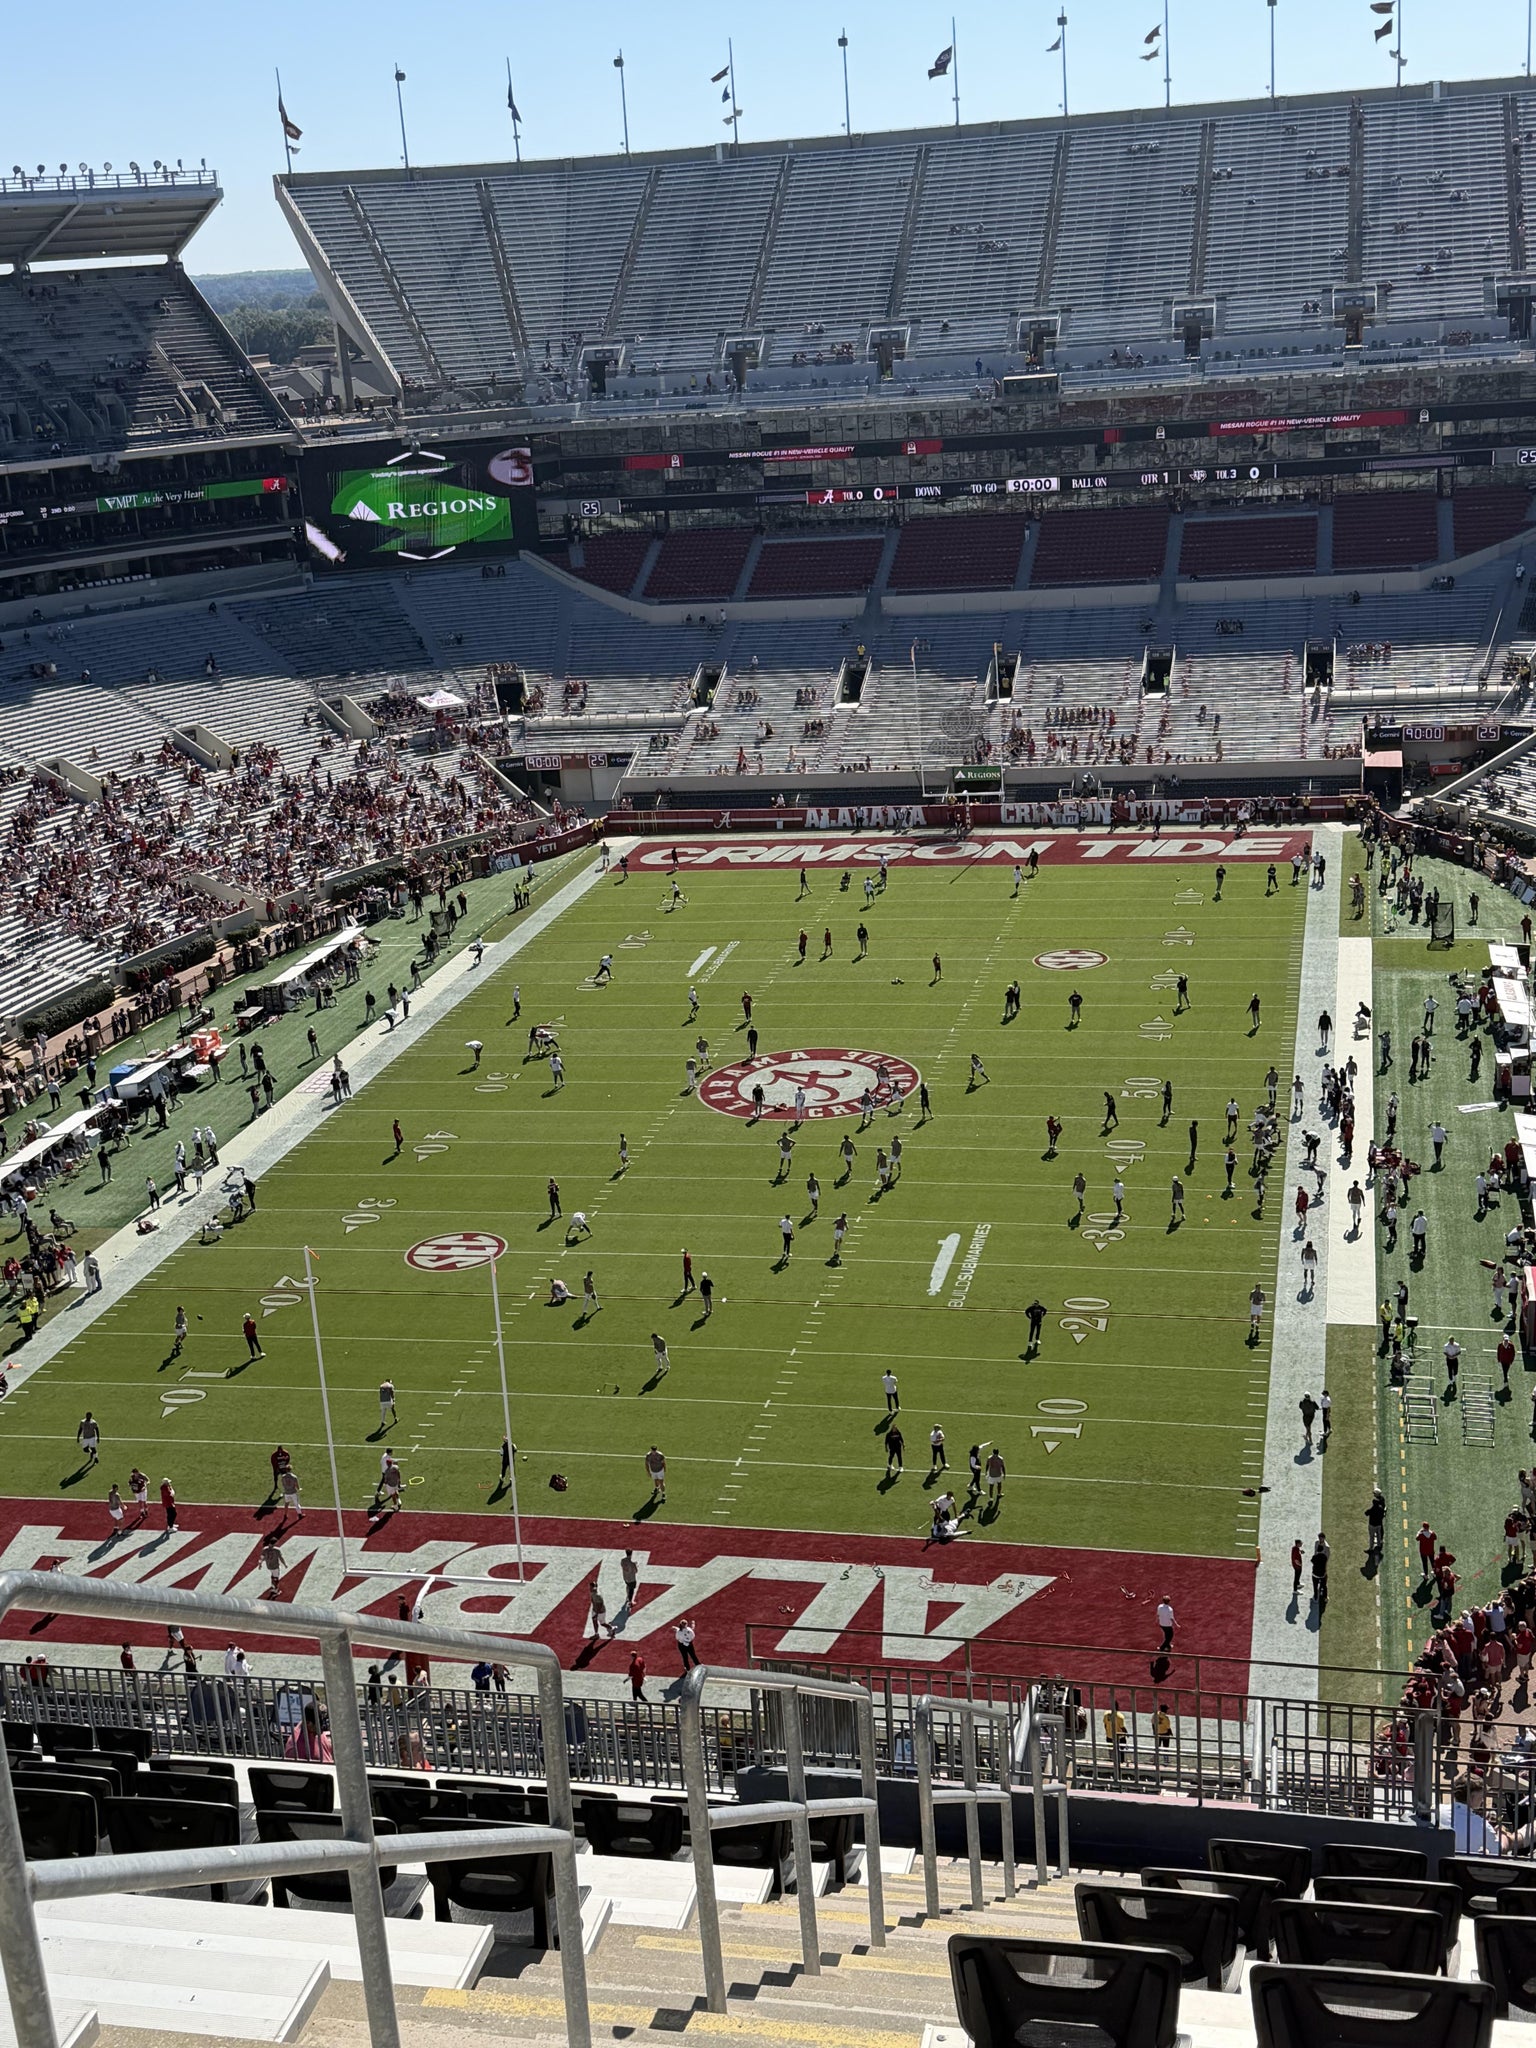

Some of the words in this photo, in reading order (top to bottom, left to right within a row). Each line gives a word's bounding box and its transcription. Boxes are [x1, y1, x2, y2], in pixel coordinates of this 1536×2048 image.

[1286, 416, 1331, 425] NEW-VEHICLE
[1332, 414, 1361, 422] QUALITY
[1521, 450, 1536, 463] 25
[1141, 473, 1158, 485] QTR
[1163, 472, 1168, 484] 1
[1215, 470, 1229, 480] TOL
[1230, 469, 1237, 479] 3
[1249, 467, 1259, 479] 0
[971, 483, 982, 494] TO
[985, 483, 997, 493] GO
[1013, 478, 1052, 491] 90:00
[1072, 478, 1093, 489] BALL
[1095, 477, 1107, 488] ON
[142, 496, 151, 504] At
[153, 494, 163, 503] the
[165, 492, 182, 503] Very
[184, 490, 205, 500] Heart
[856, 490, 863, 500] 0
[873, 487, 883, 500] 0
[915, 486, 941, 497] DOWN
[387, 496, 497, 519] REGIONS
[584, 503, 598, 514] 25
[1405, 727, 1442, 739] 90:00
[1480, 727, 1496, 738] 25
[591, 755, 604, 766] 25
[967, 771, 1001, 779] REGIONS
[536, 842, 557, 855] YETI
[640, 839, 1056, 865] CRIMSON
[1076, 837, 1293, 857] TIDE
[1136, 1021, 1174, 1041] 40
[1120, 1077, 1163, 1099] 50
[413, 1131, 460, 1154] 40
[1104, 1139, 1147, 1164] 40
[341, 1197, 398, 1225] 30
[1081, 1212, 1131, 1241] 30
[948, 1223, 992, 1308] BUILDSUBMARINES
[259, 1275, 320, 1307] 20
[1059, 1297, 1111, 1332] 20
[160, 1367, 232, 1404] 10
[1030, 1398, 1088, 1439] 10
